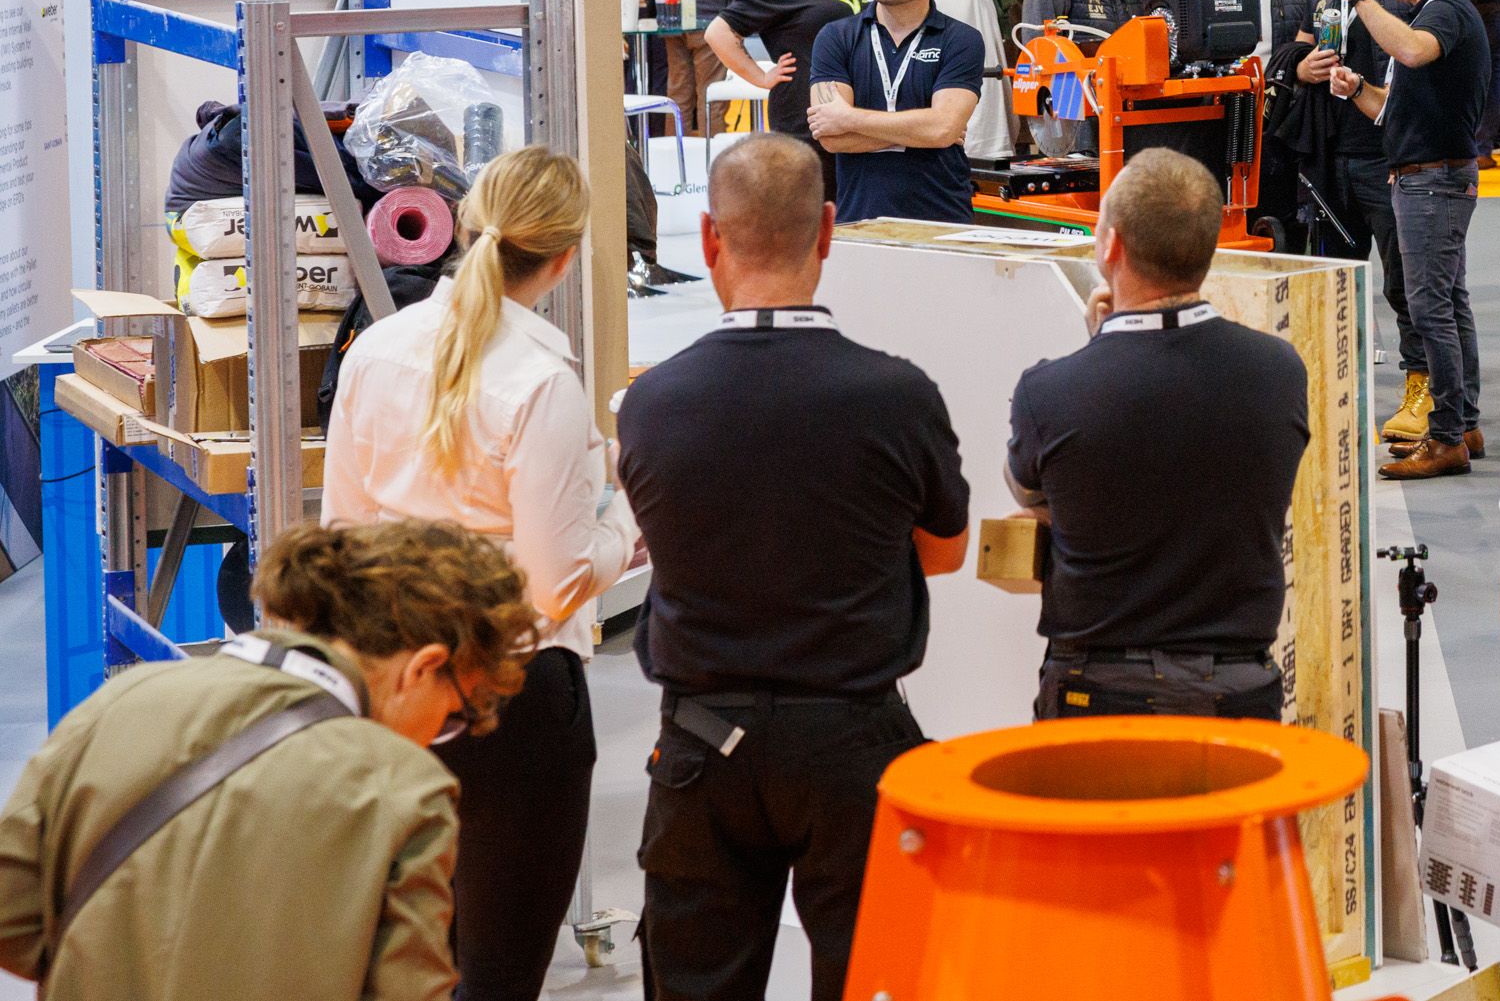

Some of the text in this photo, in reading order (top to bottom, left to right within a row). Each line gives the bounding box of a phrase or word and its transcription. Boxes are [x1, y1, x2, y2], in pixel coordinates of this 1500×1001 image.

[45, 4, 57, 17] weber
[1013, 78, 1039, 93] clipper
[1338, 391, 1348, 408] &
[1338, 423, 1351, 488] LEGAL
[1339, 501, 1352, 583] GRADED
[1341, 598, 1353, 639] DRY
[1344, 833, 1357, 916] SS/C24
